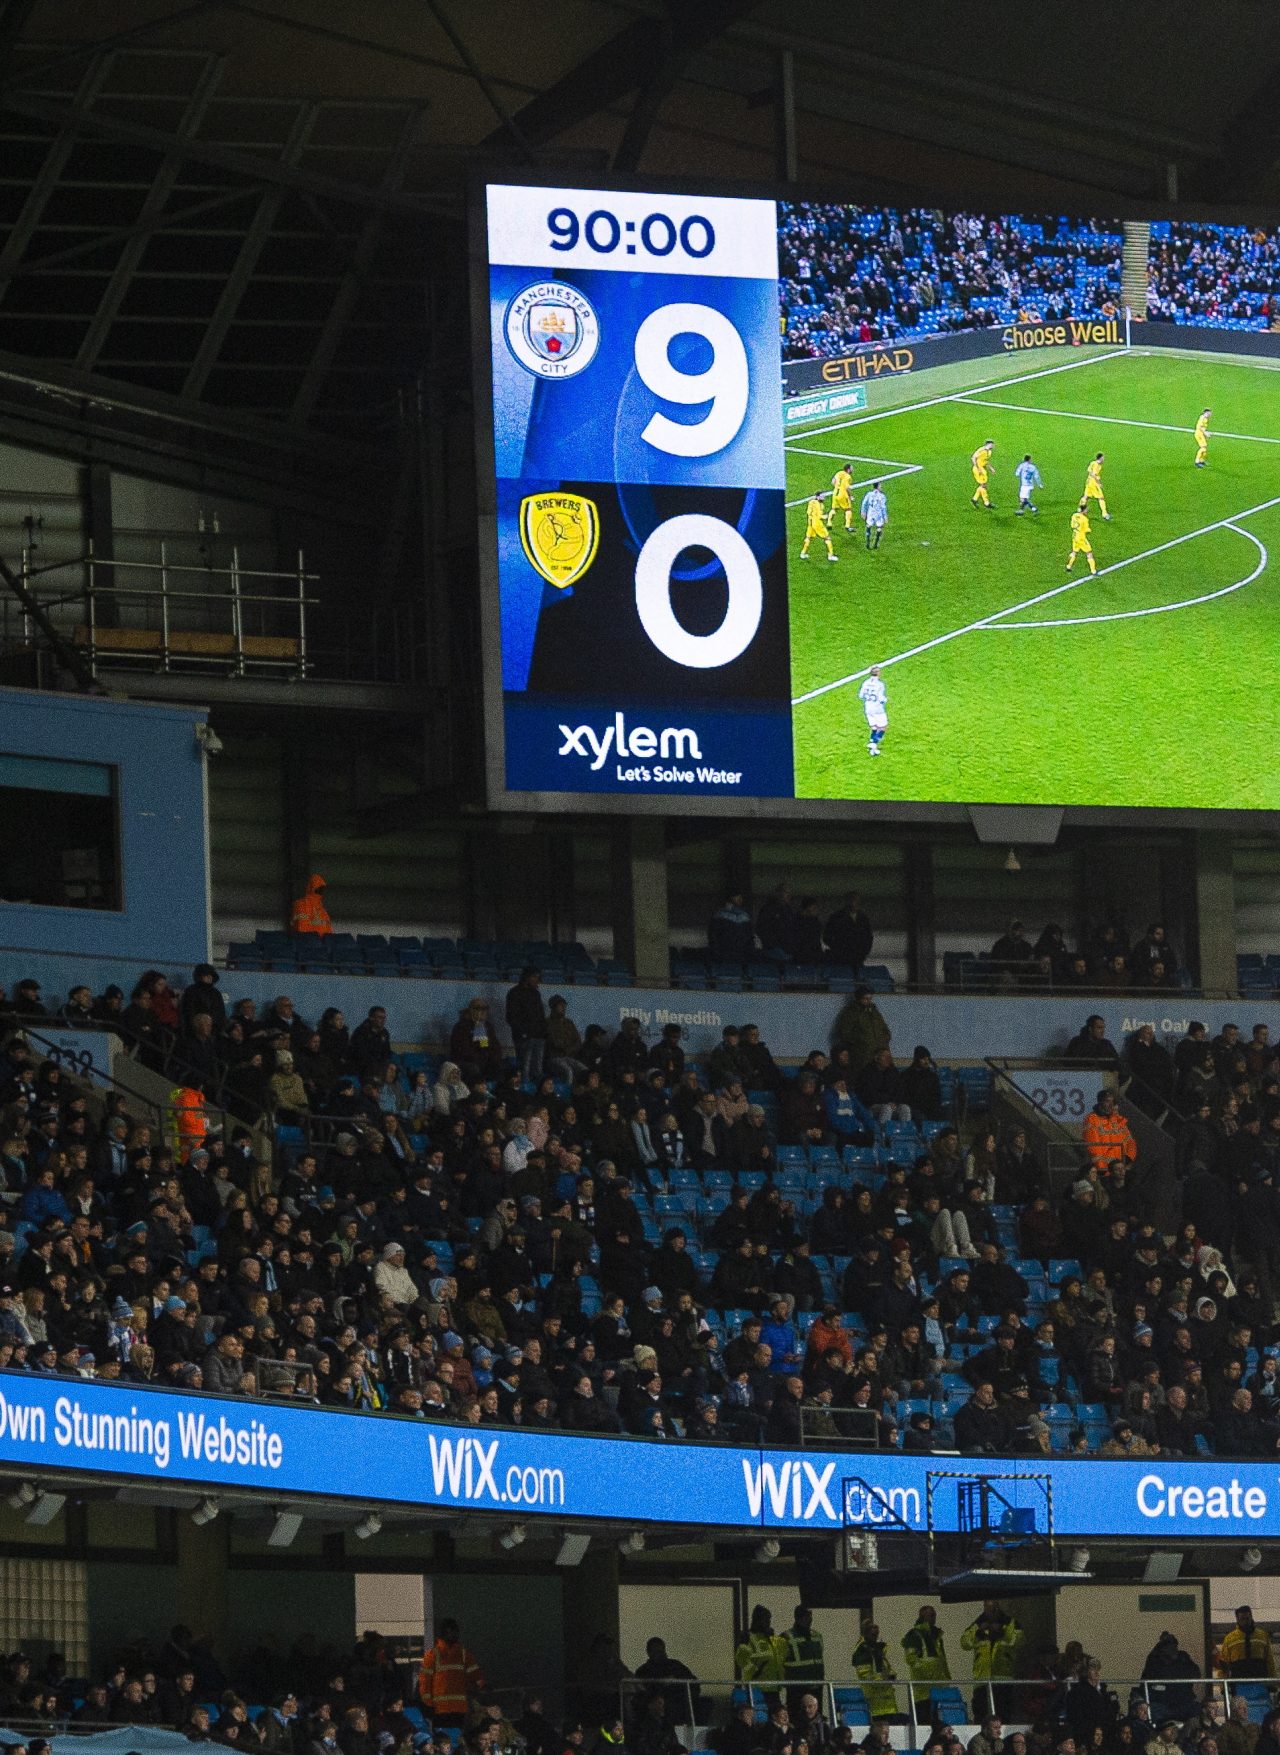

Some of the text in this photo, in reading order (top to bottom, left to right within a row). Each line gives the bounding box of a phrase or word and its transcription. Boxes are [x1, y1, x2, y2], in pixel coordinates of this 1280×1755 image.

[547, 207, 715, 258] 90:00
[515, 287, 590, 319] MANCHESTER
[1070, 320, 1124, 344] Well.
[541, 363, 568, 374] CITY
[635, 303, 749, 457] 9
[822, 349, 914, 382] ETIHAD
[787, 399, 829, 419] ENERGY
[535, 498, 581, 512] BREWERS
[635, 514, 762, 668] 0
[558, 712, 702, 770] xylem
[617, 765, 742, 784] Let's Solve Water
[655, 1009, 722, 1026] Meredith
[1032, 1088, 1085, 1116] 233
[55, 1396, 169, 1469] Stunning
[177, 1411, 283, 1469] Website
[1137, 1475, 1267, 1519] Create
